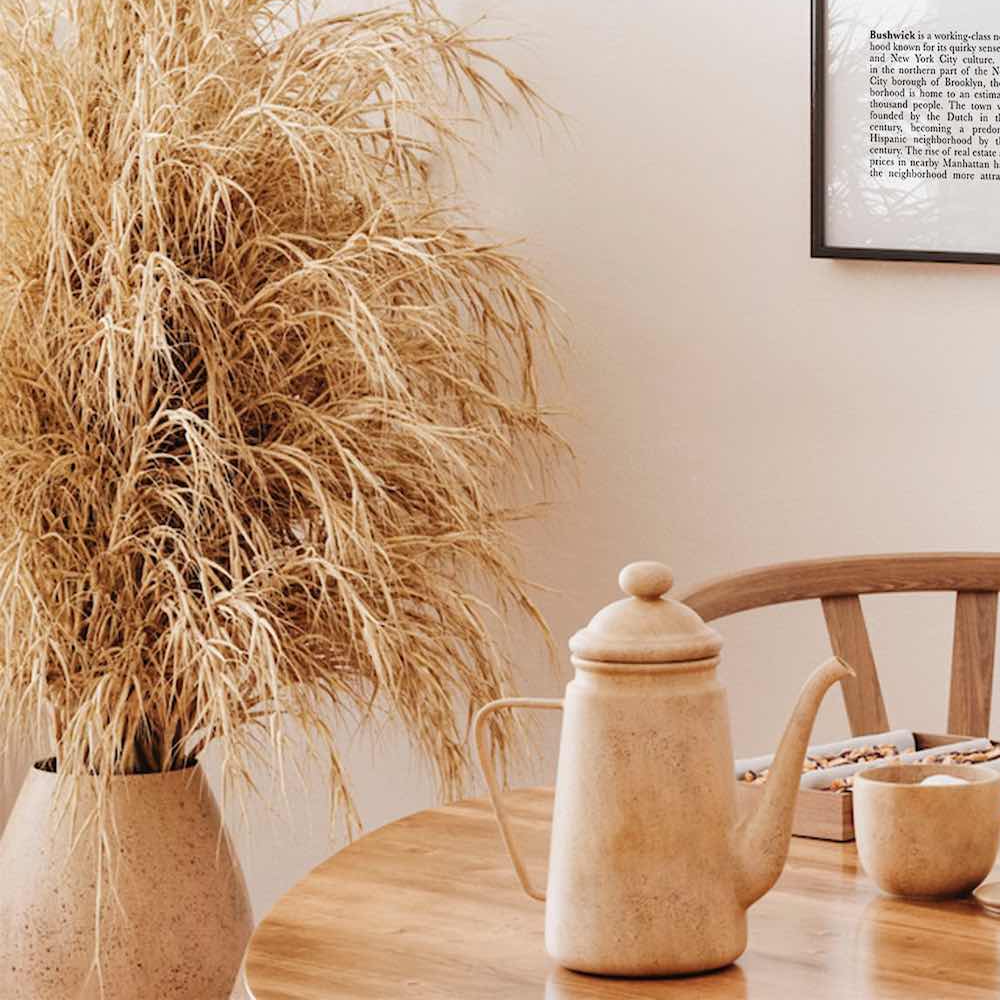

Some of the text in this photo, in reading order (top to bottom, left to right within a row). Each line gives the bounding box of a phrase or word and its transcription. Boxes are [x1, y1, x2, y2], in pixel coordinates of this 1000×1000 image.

[870, 30, 916, 40] Bushwick
[918, 30, 925, 40] is
[926, 32, 933, 40] a
[934, 30, 992, 43] working-class
[870, 41, 891, 51] hood
[893, 41, 921, 51] known
[923, 41, 936, 52] for
[937, 42, 948, 52] its
[949, 42, 977, 54] quirky
[978, 44, 1000, 52] sense
[869, 52, 886, 63] and
[890, 53, 910, 63] New
[915, 53, 935, 63] York
[938, 53, 958, 66] City
[962, 53, 995, 64] culture.
[870, 87, 906, 97] borhood
[909, 87, 916, 98] is
[919, 88, 944, 98] home
[946, 89, 956, 98] to
[869, 98, 908, 109] thousand
[912, 99, 944, 112] people.
[948, 100, 966, 110] The
[970, 101, 992, 110] town
[869, 122, 903, 134] century,
[910, 122, 952, 135] becoming
[870, 133, 908, 146] Hispanic
[913, 134, 973, 147] neighborhood
[978, 135, 989, 148] by
[869, 156, 895, 169] prices
[898, 156, 907, 166] in
[910, 157, 940, 170] nearby
[942, 157, 990, 168] Manhattan
[870, 167, 883, 178] the
[888, 168, 948, 182] neighborhood
[952, 172, 975, 180] more
